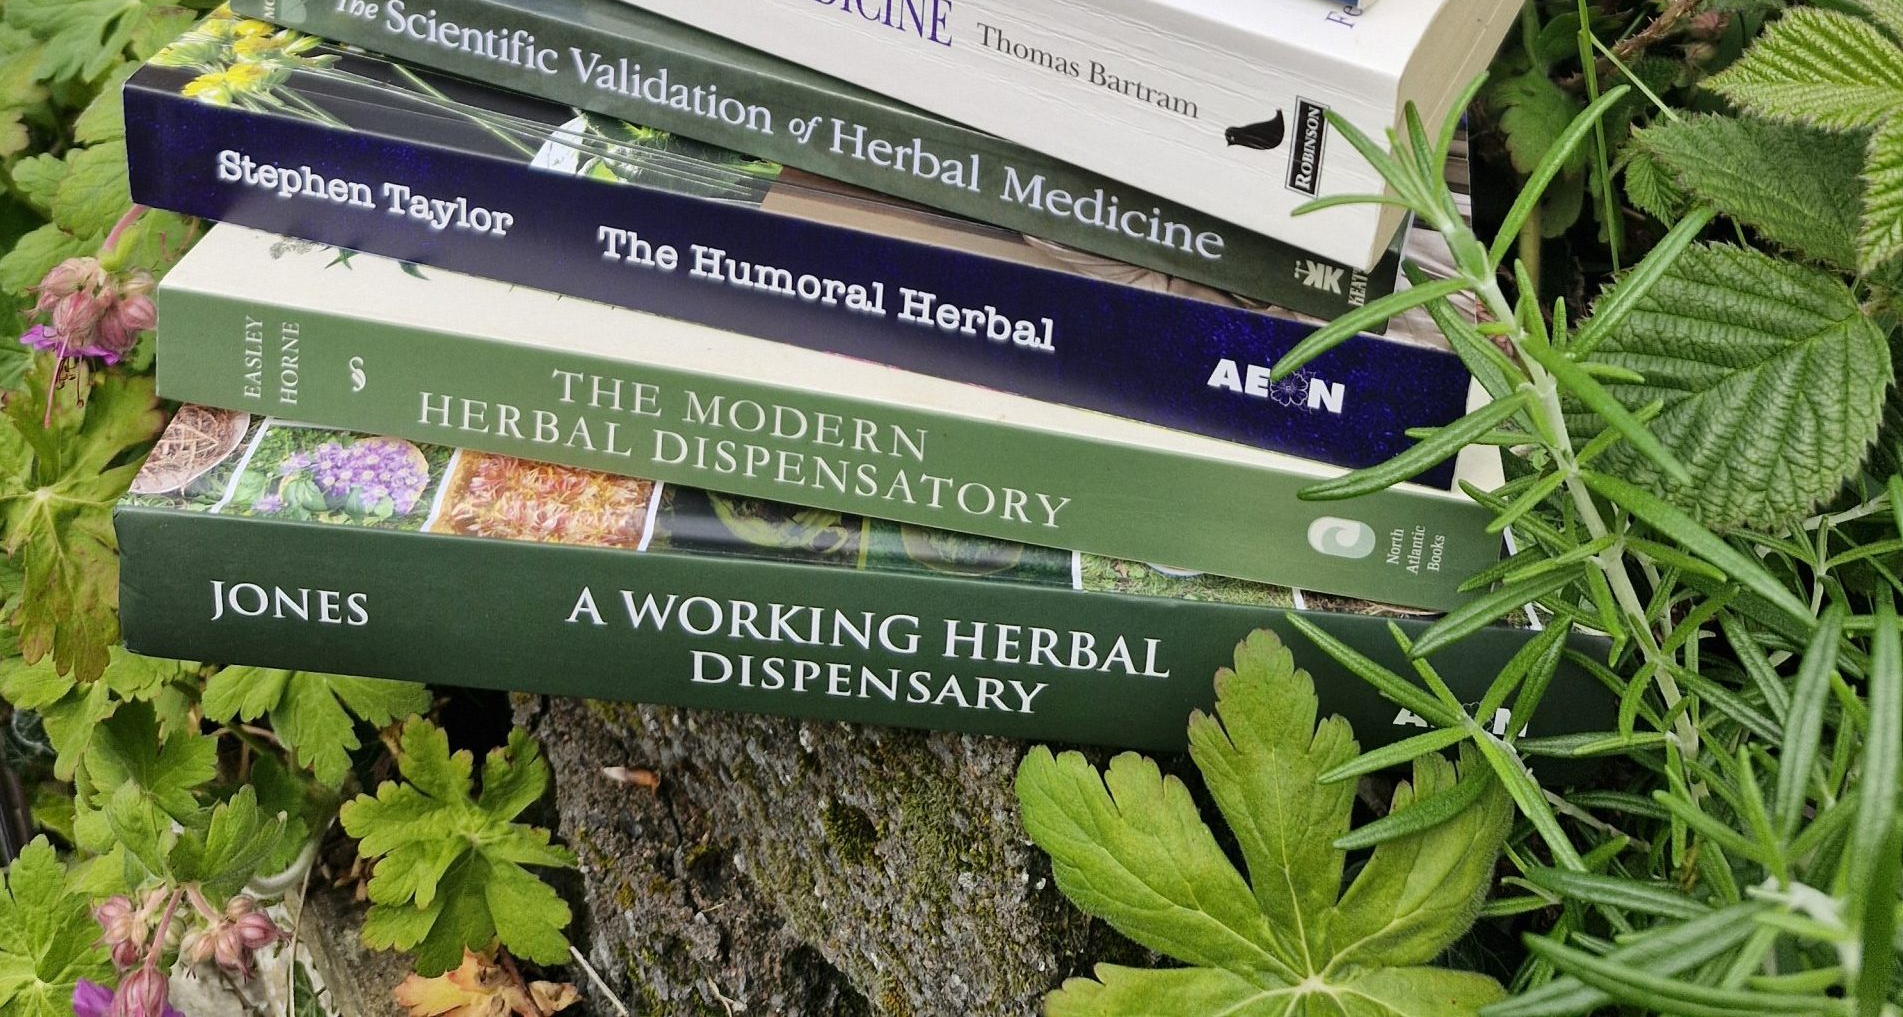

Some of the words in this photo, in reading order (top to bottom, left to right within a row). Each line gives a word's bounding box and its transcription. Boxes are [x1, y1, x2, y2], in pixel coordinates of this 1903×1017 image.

[976, 22, 1080, 78] Thomas
[1087, 59, 1200, 119] Bartram
[568, 46, 774, 134] Validation
[788, 115, 822, 144] of
[829, 117, 981, 193] Herbal
[1000, 165, 1225, 260] Medicine
[1294, 106, 1321, 191] ROBINSON
[217, 149, 376, 209] Stephen
[383, 181, 514, 235] Taylor
[598, 225, 678, 270] The
[689, 244, 886, 315] Humoral
[898, 287, 1056, 352] Herbal
[244, 315, 263, 399] EASLEY
[280, 321, 300, 406] HORNE
[552, 368, 662, 417] THE
[681, 390, 929, 462] MODERN
[417, 391, 632, 457] HERBAL
[651, 428, 1072, 528] DISPENSATORY
[1386, 528, 1405, 565] North
[1406, 525, 1426, 575] Atlantic
[1426, 534, 1446, 572] Books
[210, 580, 369, 626] JONES
[565, 586, 608, 625] A
[619, 589, 922, 655] WORKING
[941, 618, 1170, 678] HERBAL
[689, 650, 1050, 714] DISPENSARY
